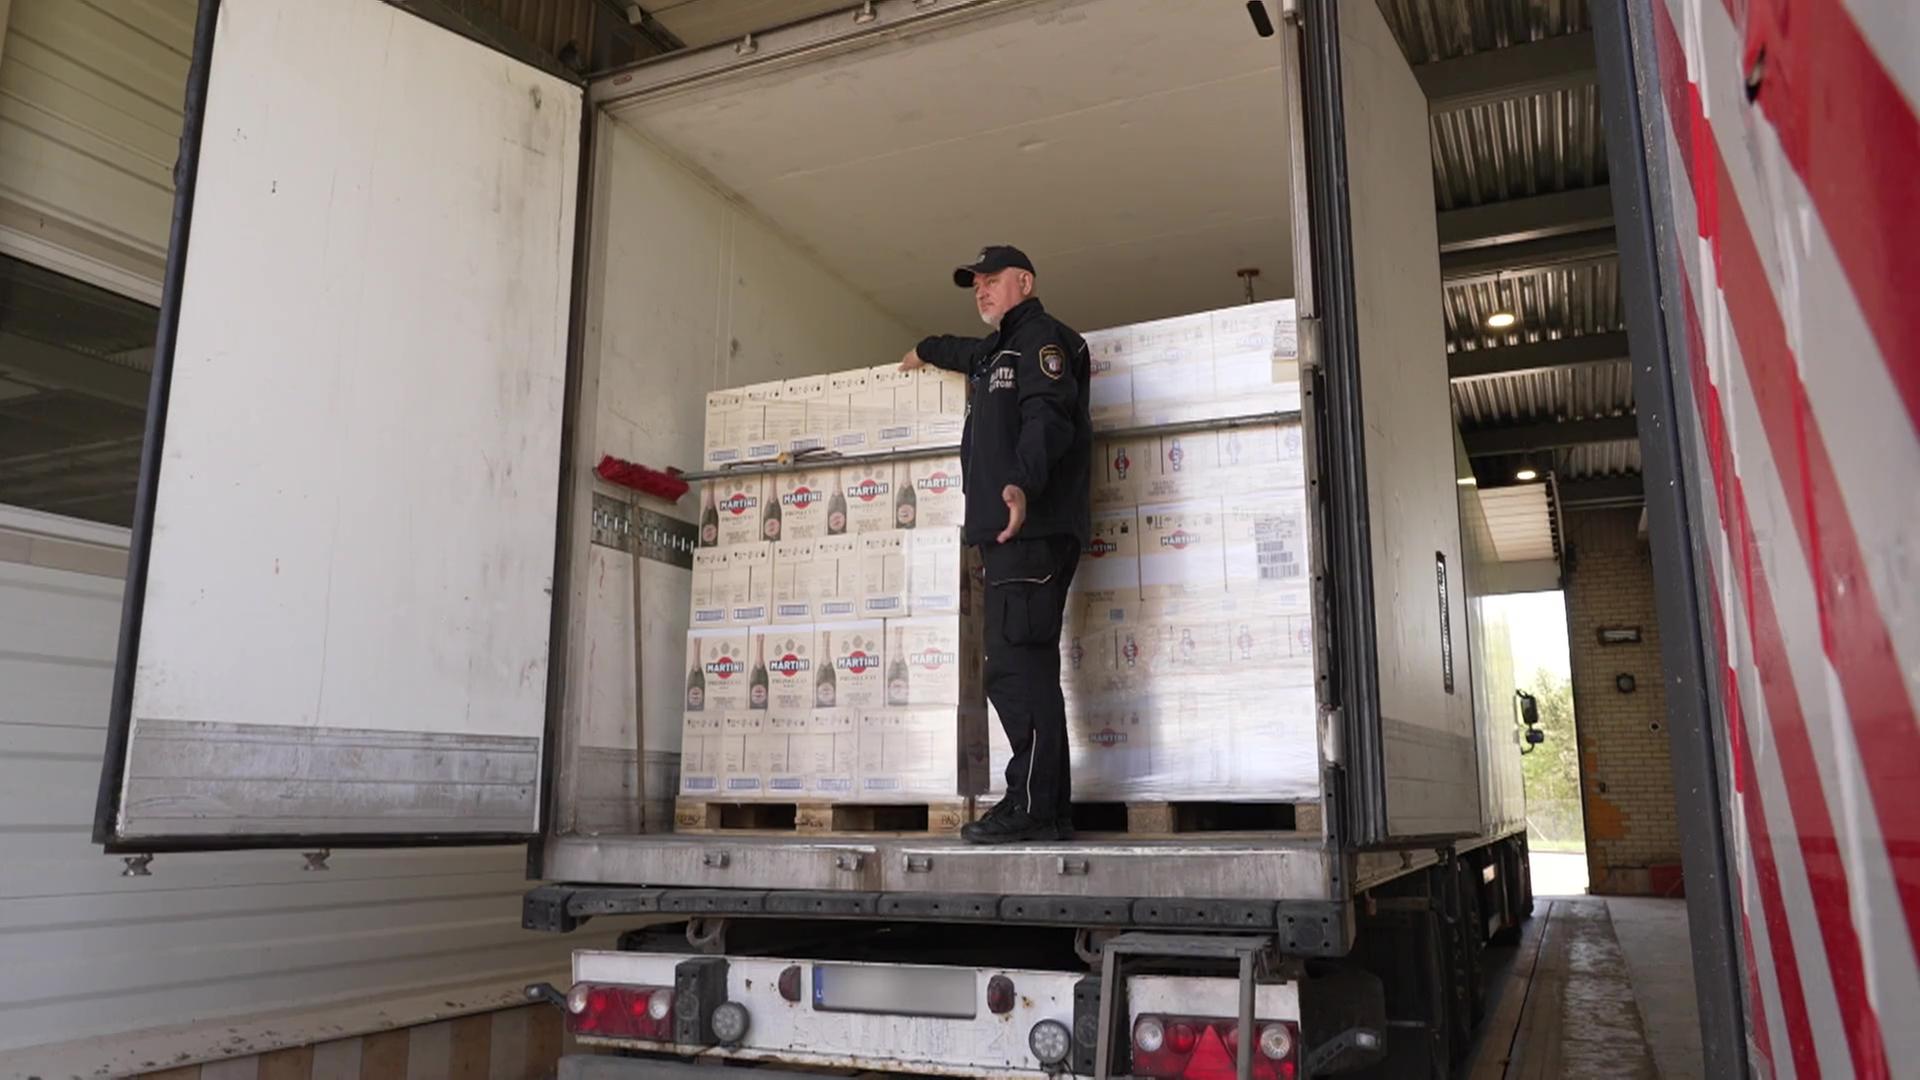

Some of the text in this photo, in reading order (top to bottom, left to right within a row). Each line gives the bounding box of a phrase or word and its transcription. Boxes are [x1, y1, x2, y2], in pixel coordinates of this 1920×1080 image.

[918, 475, 960, 489] MARTINI
[847, 483, 888, 497] MARTINI
[720, 496, 757, 511] MARTINI
[783, 491, 822, 505] MARTINI
[769, 659, 809, 671] MARTINI
[836, 655, 879, 668] MARTINI
[910, 653, 955, 665] MARTINI
[706, 661, 743, 673] MARTINI
